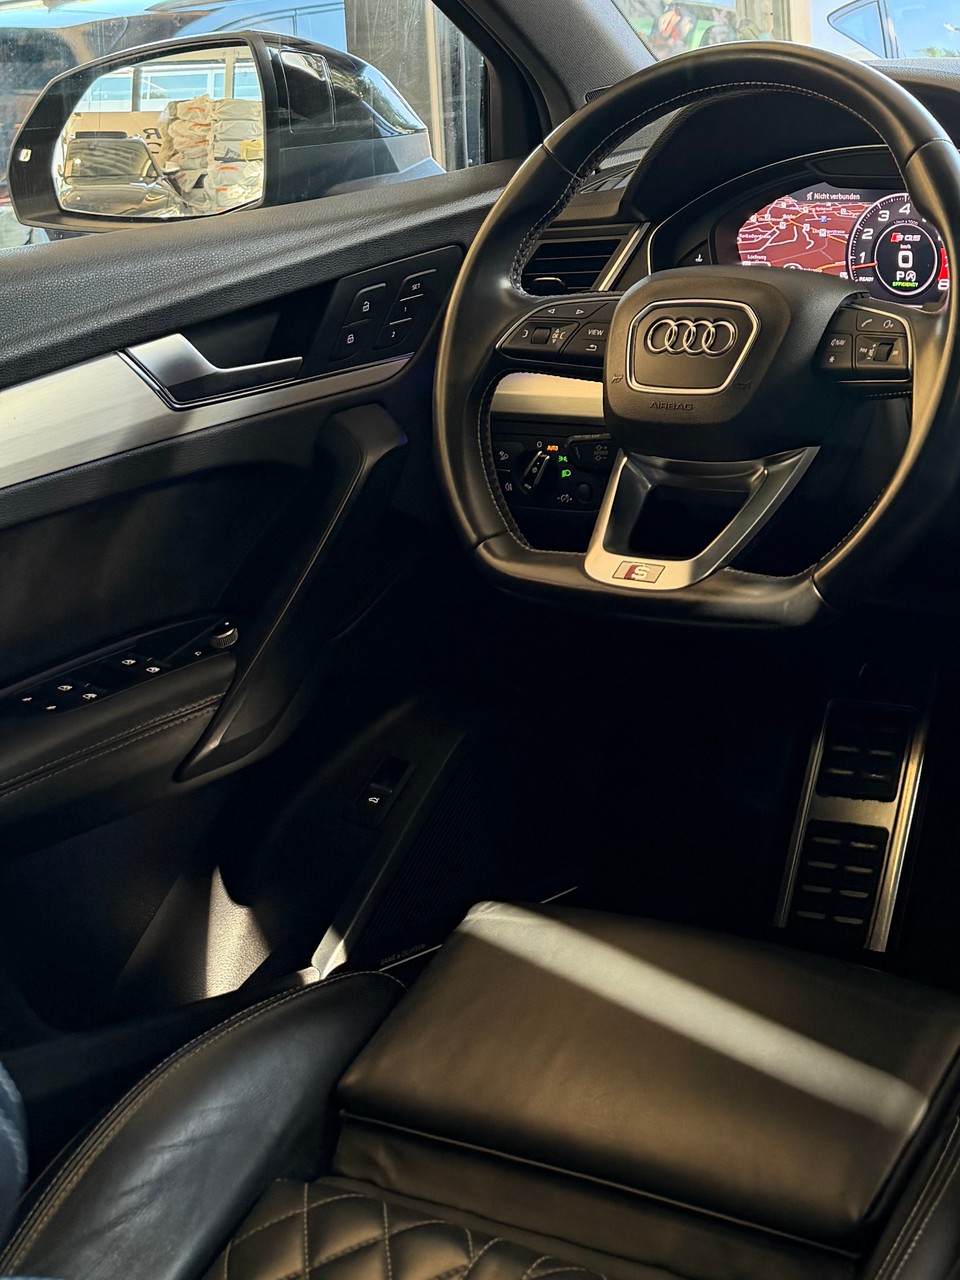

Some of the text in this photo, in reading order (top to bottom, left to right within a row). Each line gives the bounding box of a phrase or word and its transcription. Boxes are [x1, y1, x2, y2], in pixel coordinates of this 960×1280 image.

[814, 192, 860, 200] Nicht verbunden
[899, 203, 911, 215] 4
[878, 210, 890, 221] 3
[862, 228, 874, 239] 2
[860, 251, 866, 263] 1
[898, 251, 913, 268] 0
[897, 271, 905, 281] P
[938, 279, 950, 289] 8
[650, 401, 694, 411] AIRBAG
